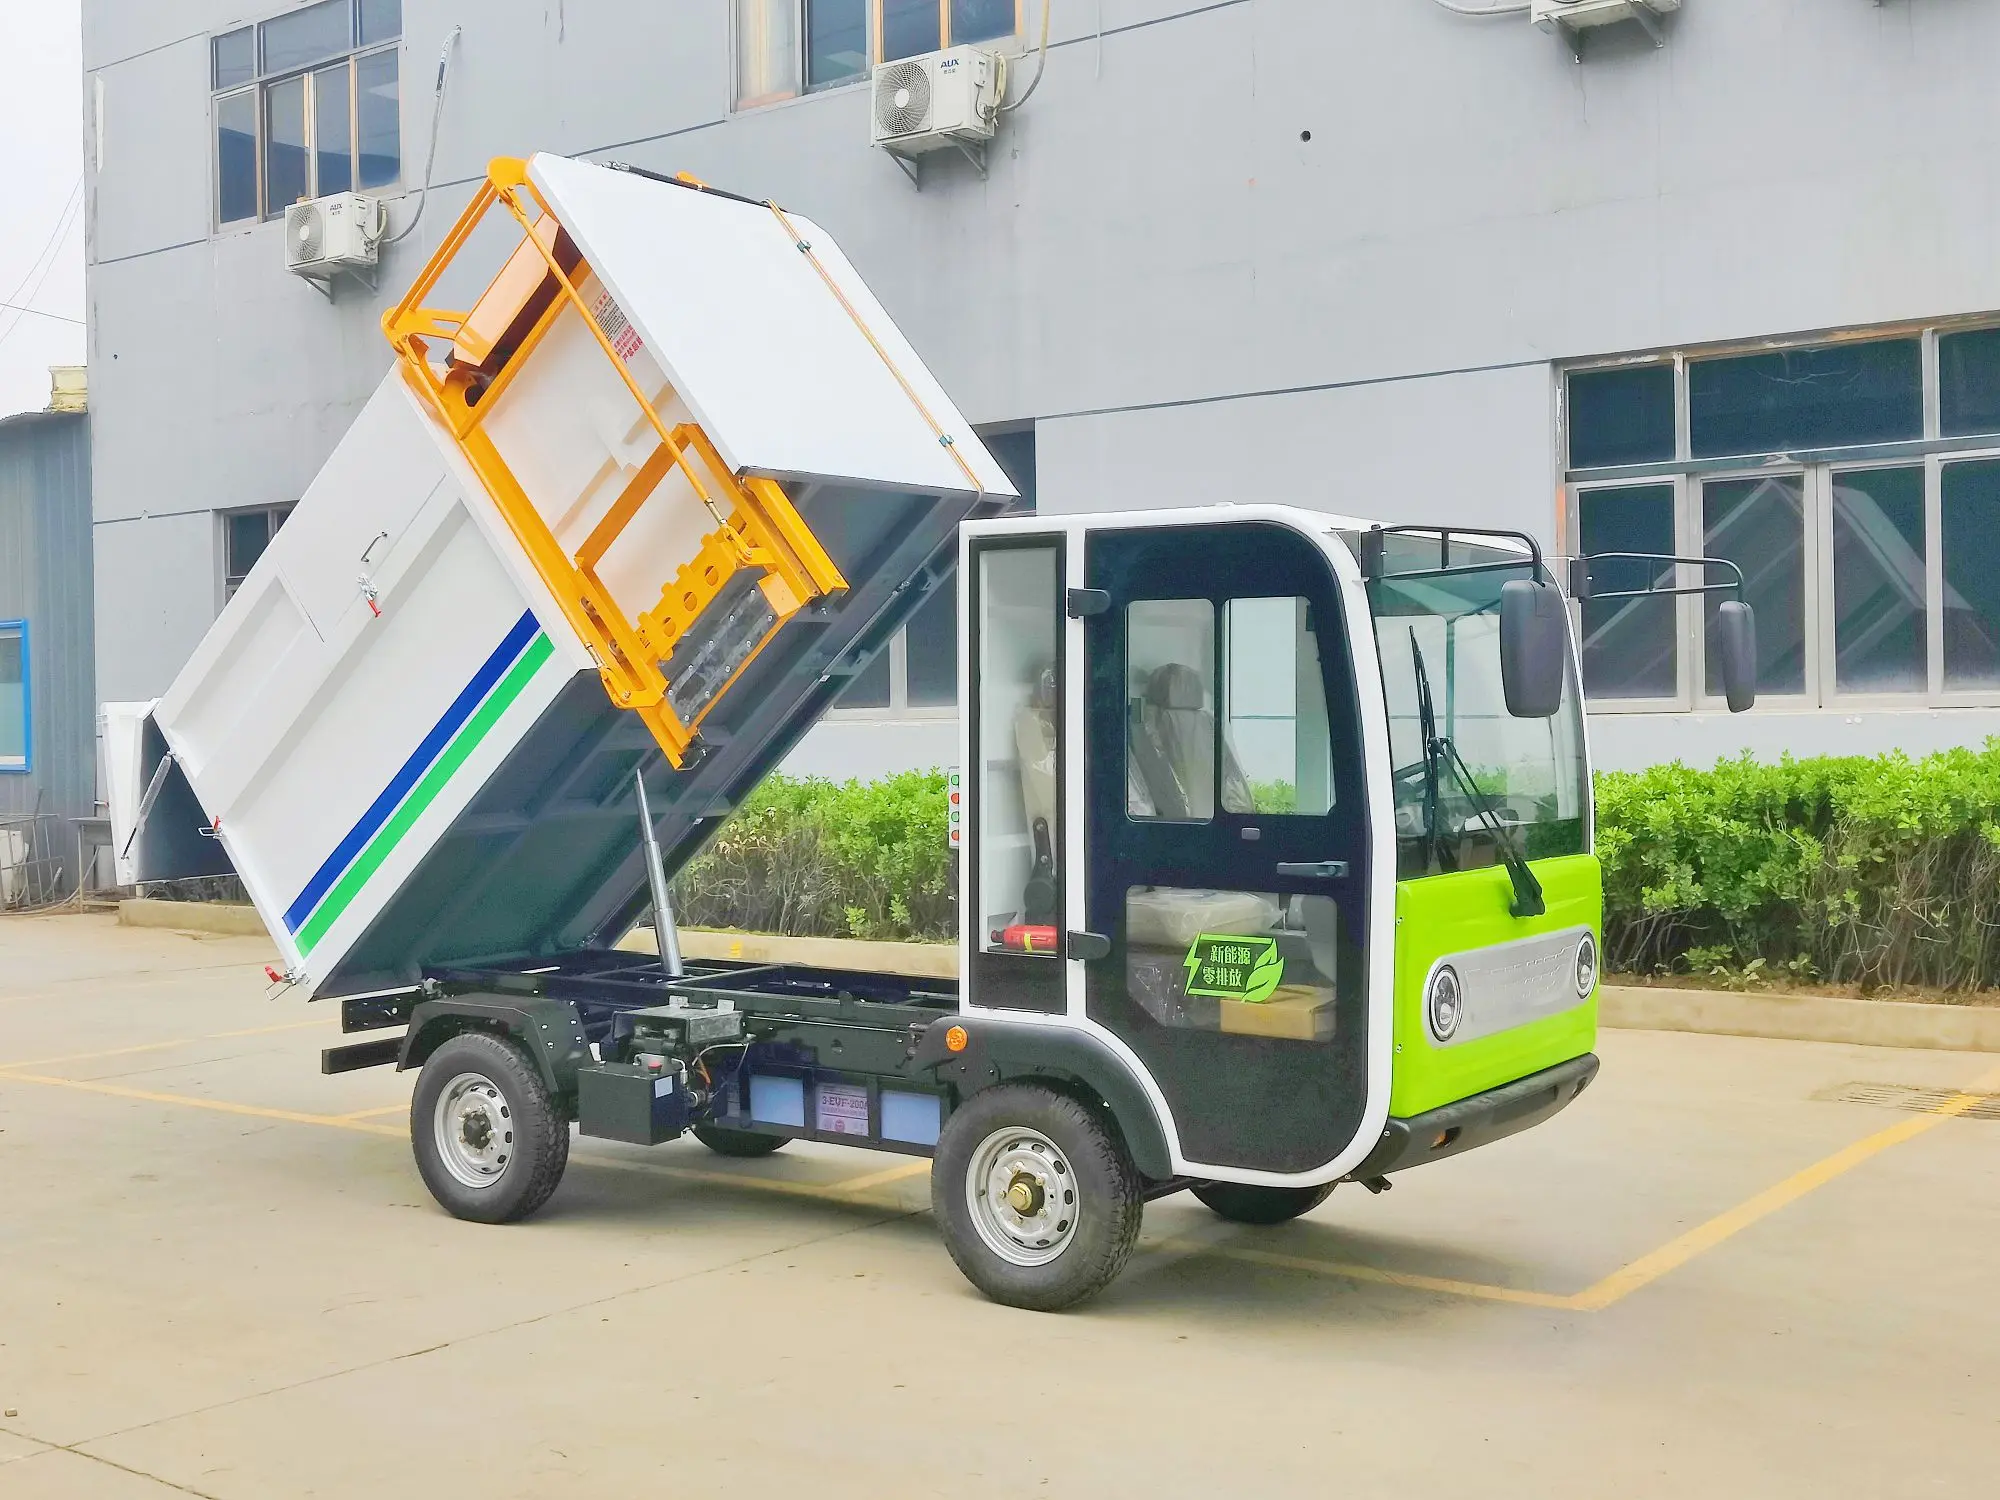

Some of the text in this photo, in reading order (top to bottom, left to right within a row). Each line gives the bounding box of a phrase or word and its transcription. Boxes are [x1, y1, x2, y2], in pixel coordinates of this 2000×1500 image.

[940, 58, 960, 69] AUX
[1210, 944, 1251, 965] 新能源
[1202, 966, 1242, 987] 零排放
